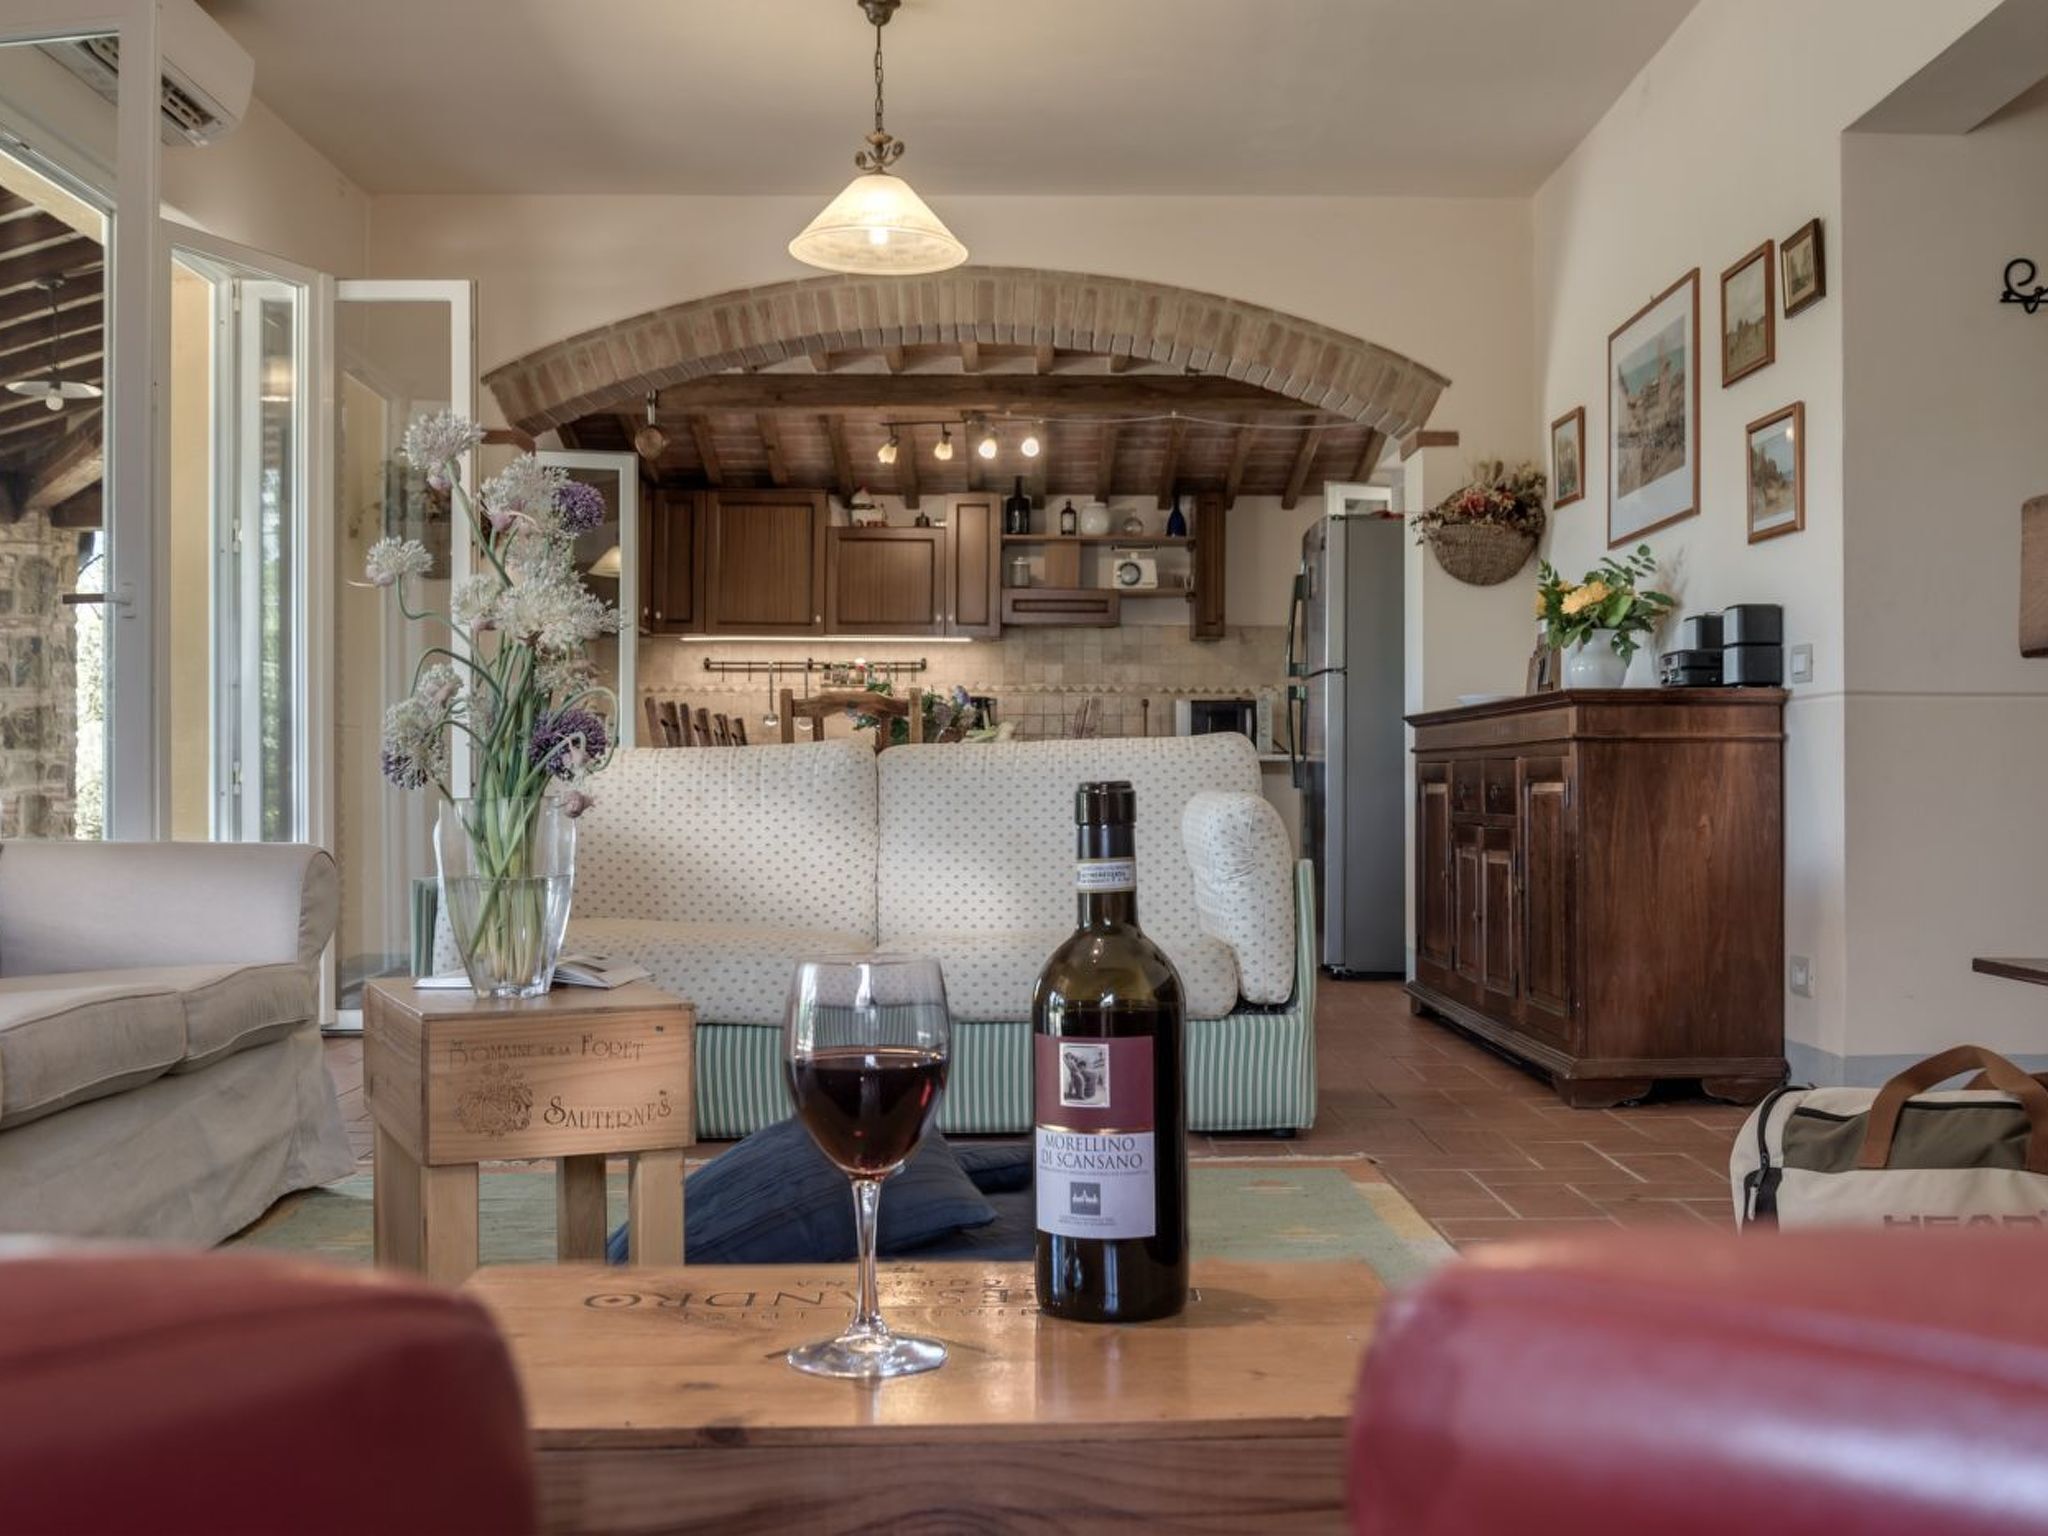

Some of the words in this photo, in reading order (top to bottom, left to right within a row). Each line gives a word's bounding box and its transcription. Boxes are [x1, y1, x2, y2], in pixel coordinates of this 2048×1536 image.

[543, 1095, 672, 1130] SAUTERNES
[1045, 1133, 1136, 1152] MORELLINO
[1041, 1148, 1052, 1165] DI
[1056, 1152, 1143, 1170] SCANSANO
